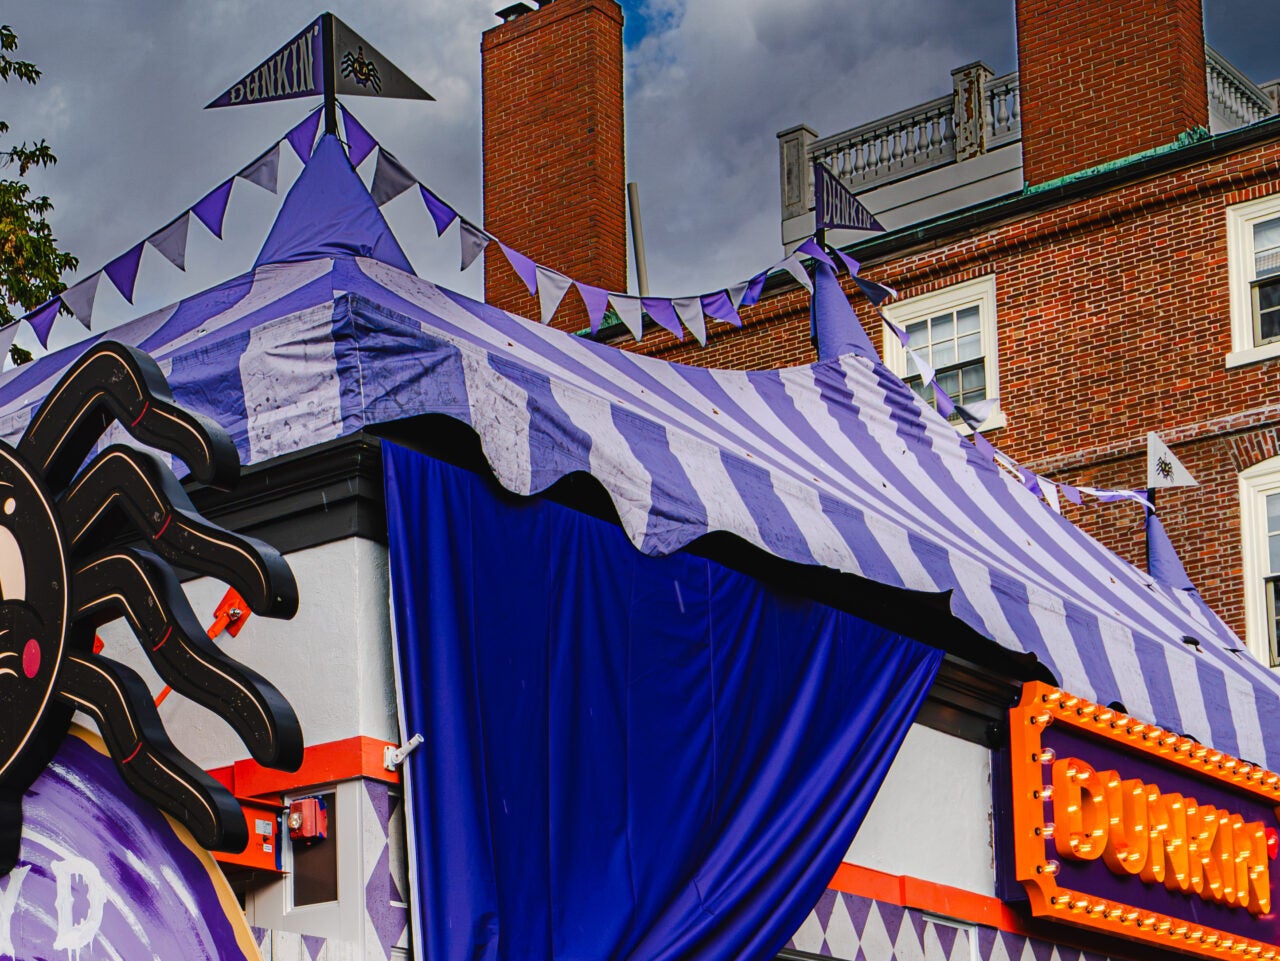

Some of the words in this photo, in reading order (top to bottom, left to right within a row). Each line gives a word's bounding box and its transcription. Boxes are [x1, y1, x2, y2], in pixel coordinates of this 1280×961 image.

[229, 25, 320, 104] DUNKIN'
[822, 171, 875, 229] DUNKIN'
[1052, 757, 1278, 915] DUNKIN'
